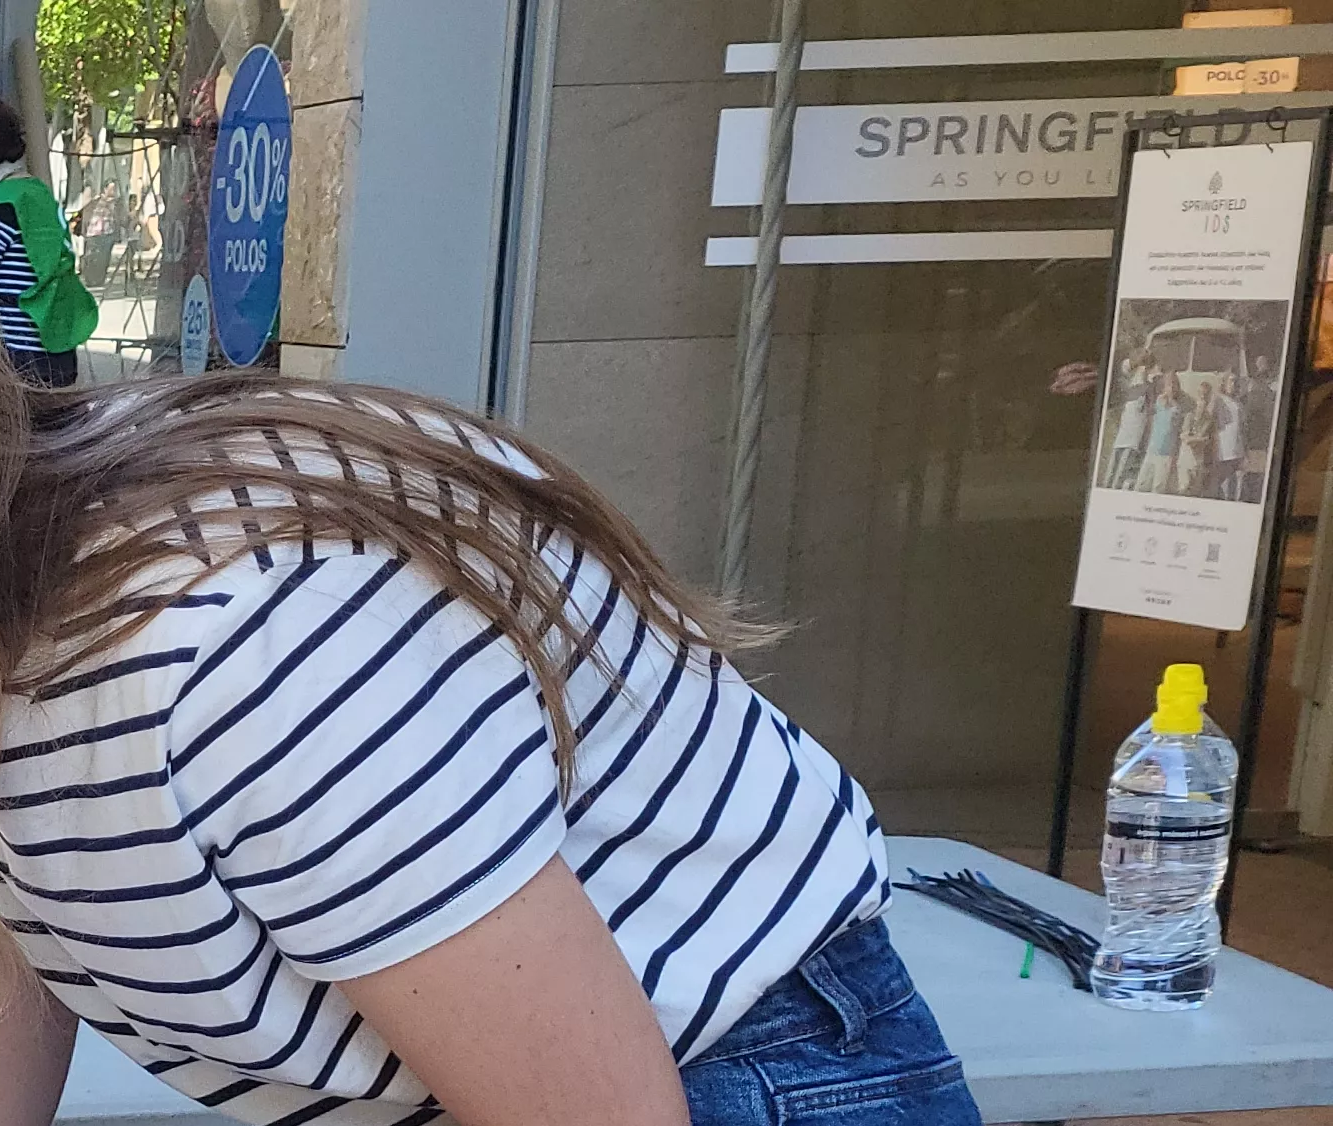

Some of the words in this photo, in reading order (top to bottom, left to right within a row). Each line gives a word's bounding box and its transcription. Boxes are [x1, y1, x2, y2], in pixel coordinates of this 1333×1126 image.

[216, 122, 288, 223] -30%
[930, 172, 969, 187] AS
[994, 169, 1060, 187] YOU
[1181, 198, 1247, 212] SPRINGFIELD
[225, 239, 267, 272] POLOS
